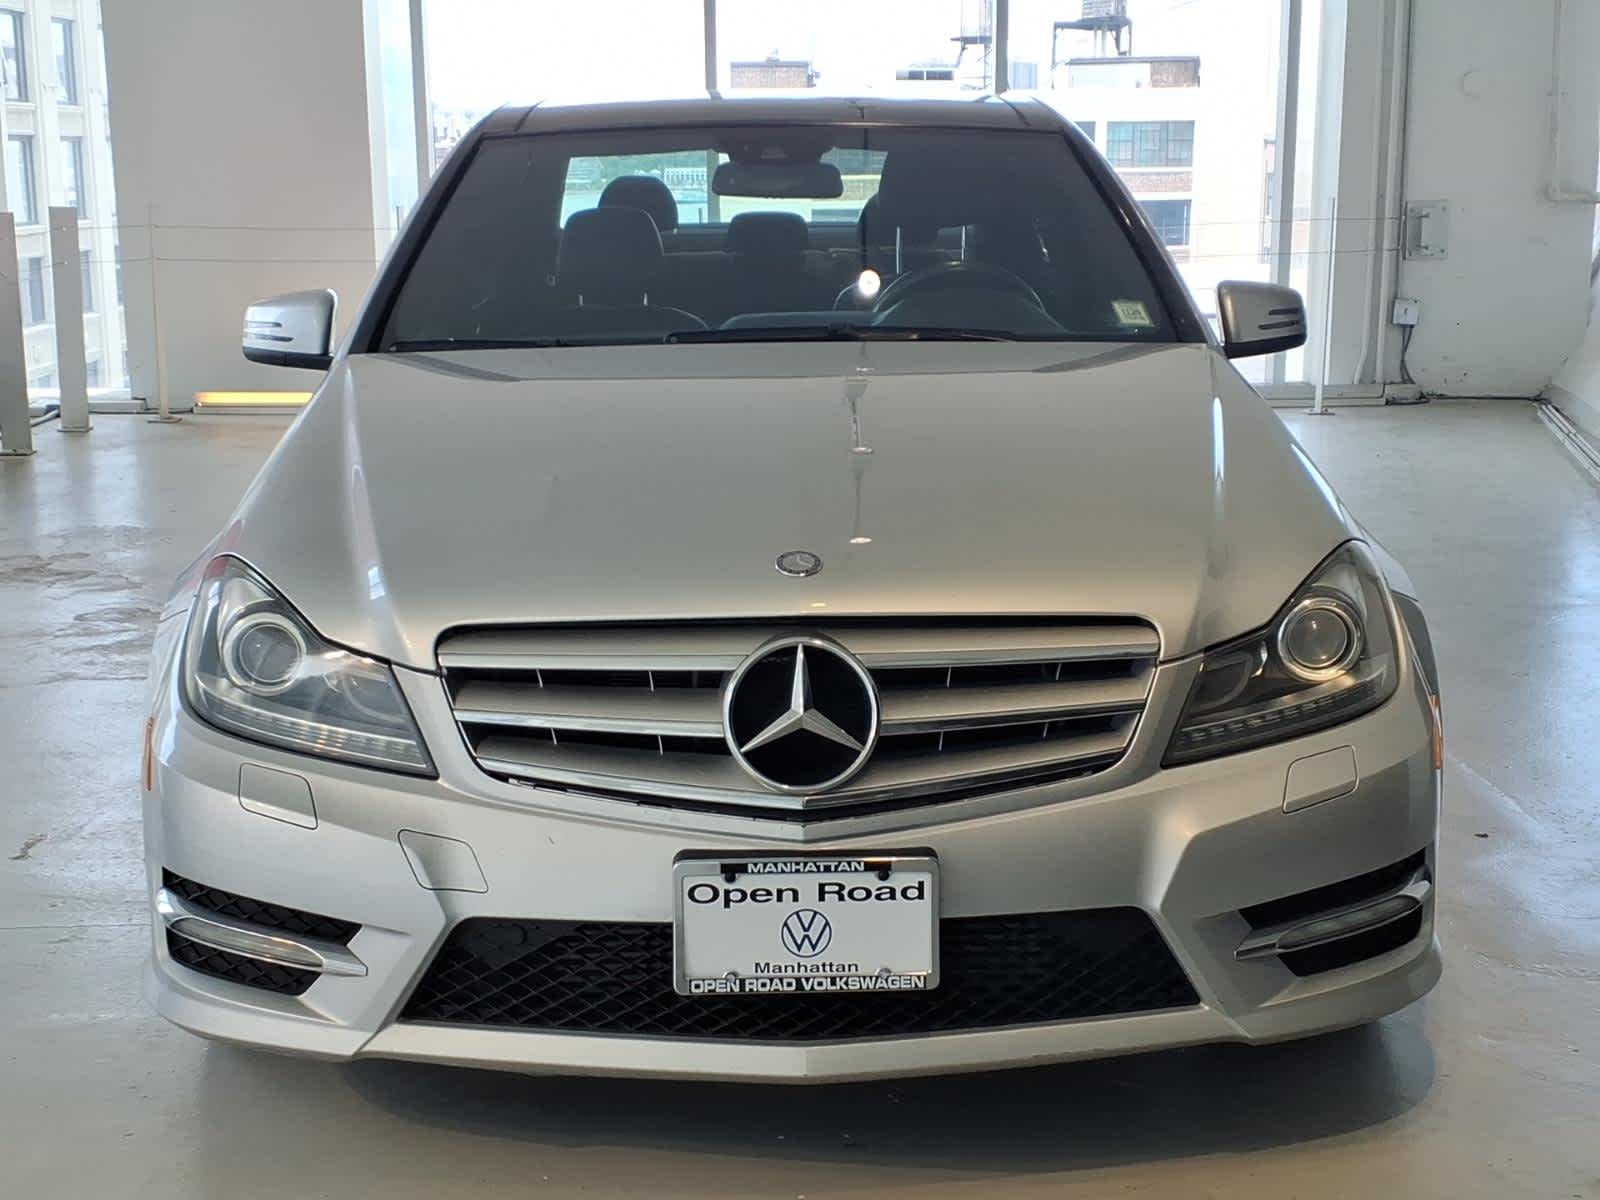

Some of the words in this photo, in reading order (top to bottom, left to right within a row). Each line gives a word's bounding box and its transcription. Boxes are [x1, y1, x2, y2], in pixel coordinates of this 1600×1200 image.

[747, 861, 865, 873] MANHATTAN
[687, 883, 799, 908] Open
[818, 881, 925, 902] Road
[754, 961, 859, 973] Manhattan
[691, 979, 740, 993] OPEN
[745, 978, 796, 992] ROAD
[801, 976, 925, 991] VOLKSWAGEN
